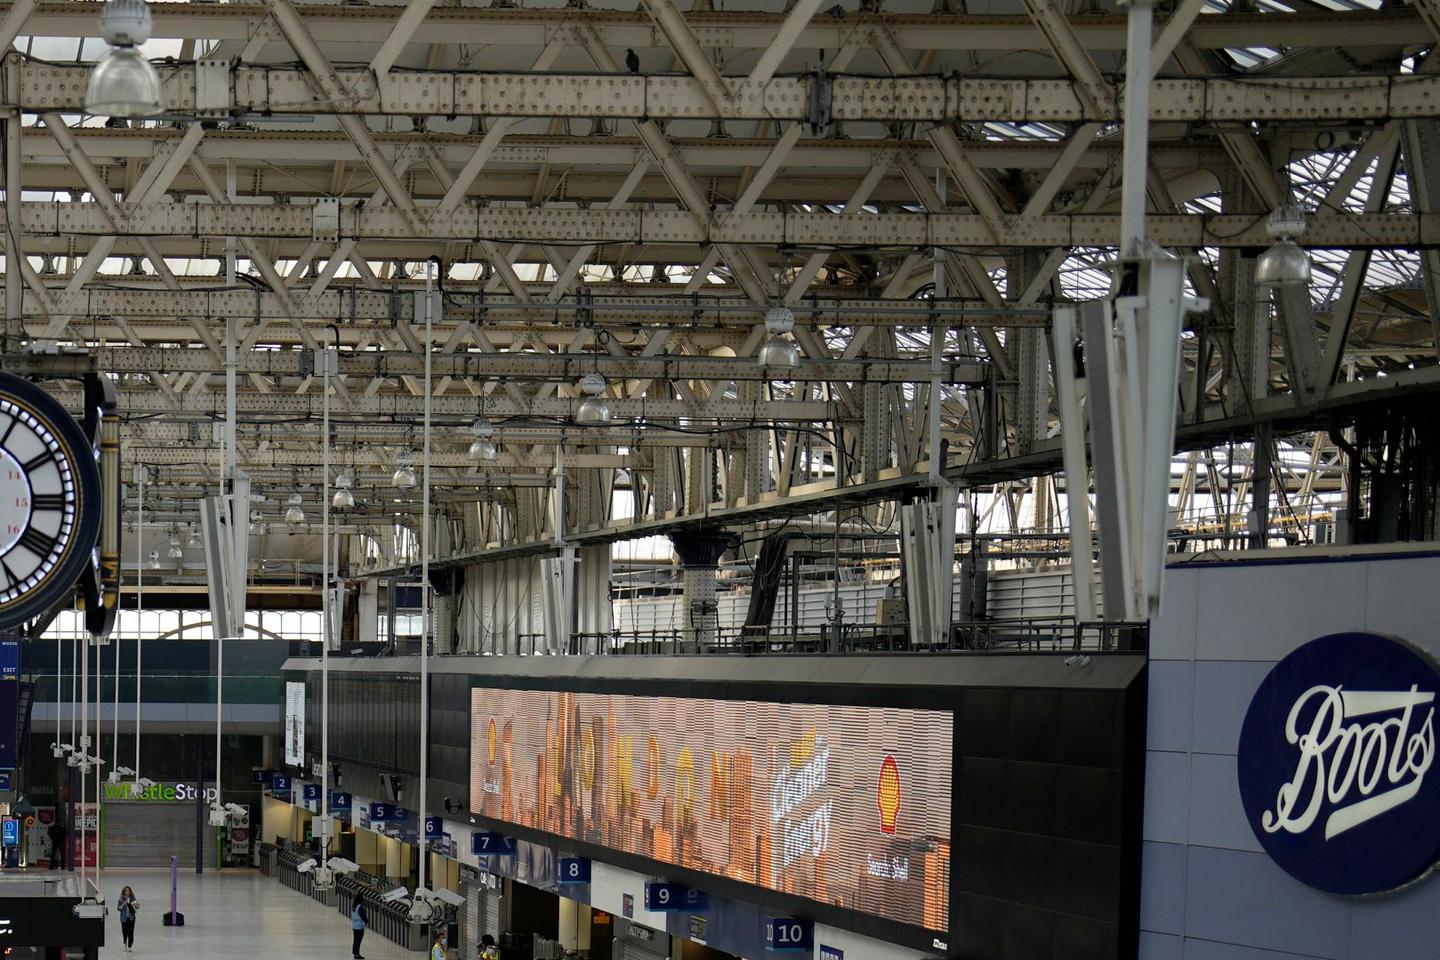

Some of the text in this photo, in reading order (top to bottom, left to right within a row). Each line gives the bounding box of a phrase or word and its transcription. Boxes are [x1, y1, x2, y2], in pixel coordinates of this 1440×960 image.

[8, 470, 21, 480] 14
[15, 497, 28, 507] 15
[7, 524, 20, 535] 16
[1262, 684, 1436, 842] Boots
[279, 779, 286, 788] 2
[104, 783, 217, 804] WstleStp
[309, 787, 316, 796] 3
[337, 795, 345, 805] 4
[377, 806, 384, 817] 5
[425, 821, 433, 832] 6
[481, 837, 489, 849] 7
[569, 862, 579, 877] 8
[659, 889, 670, 904] 9
[766, 924, 774, 941] 10
[778, 925, 802, 942] 10
